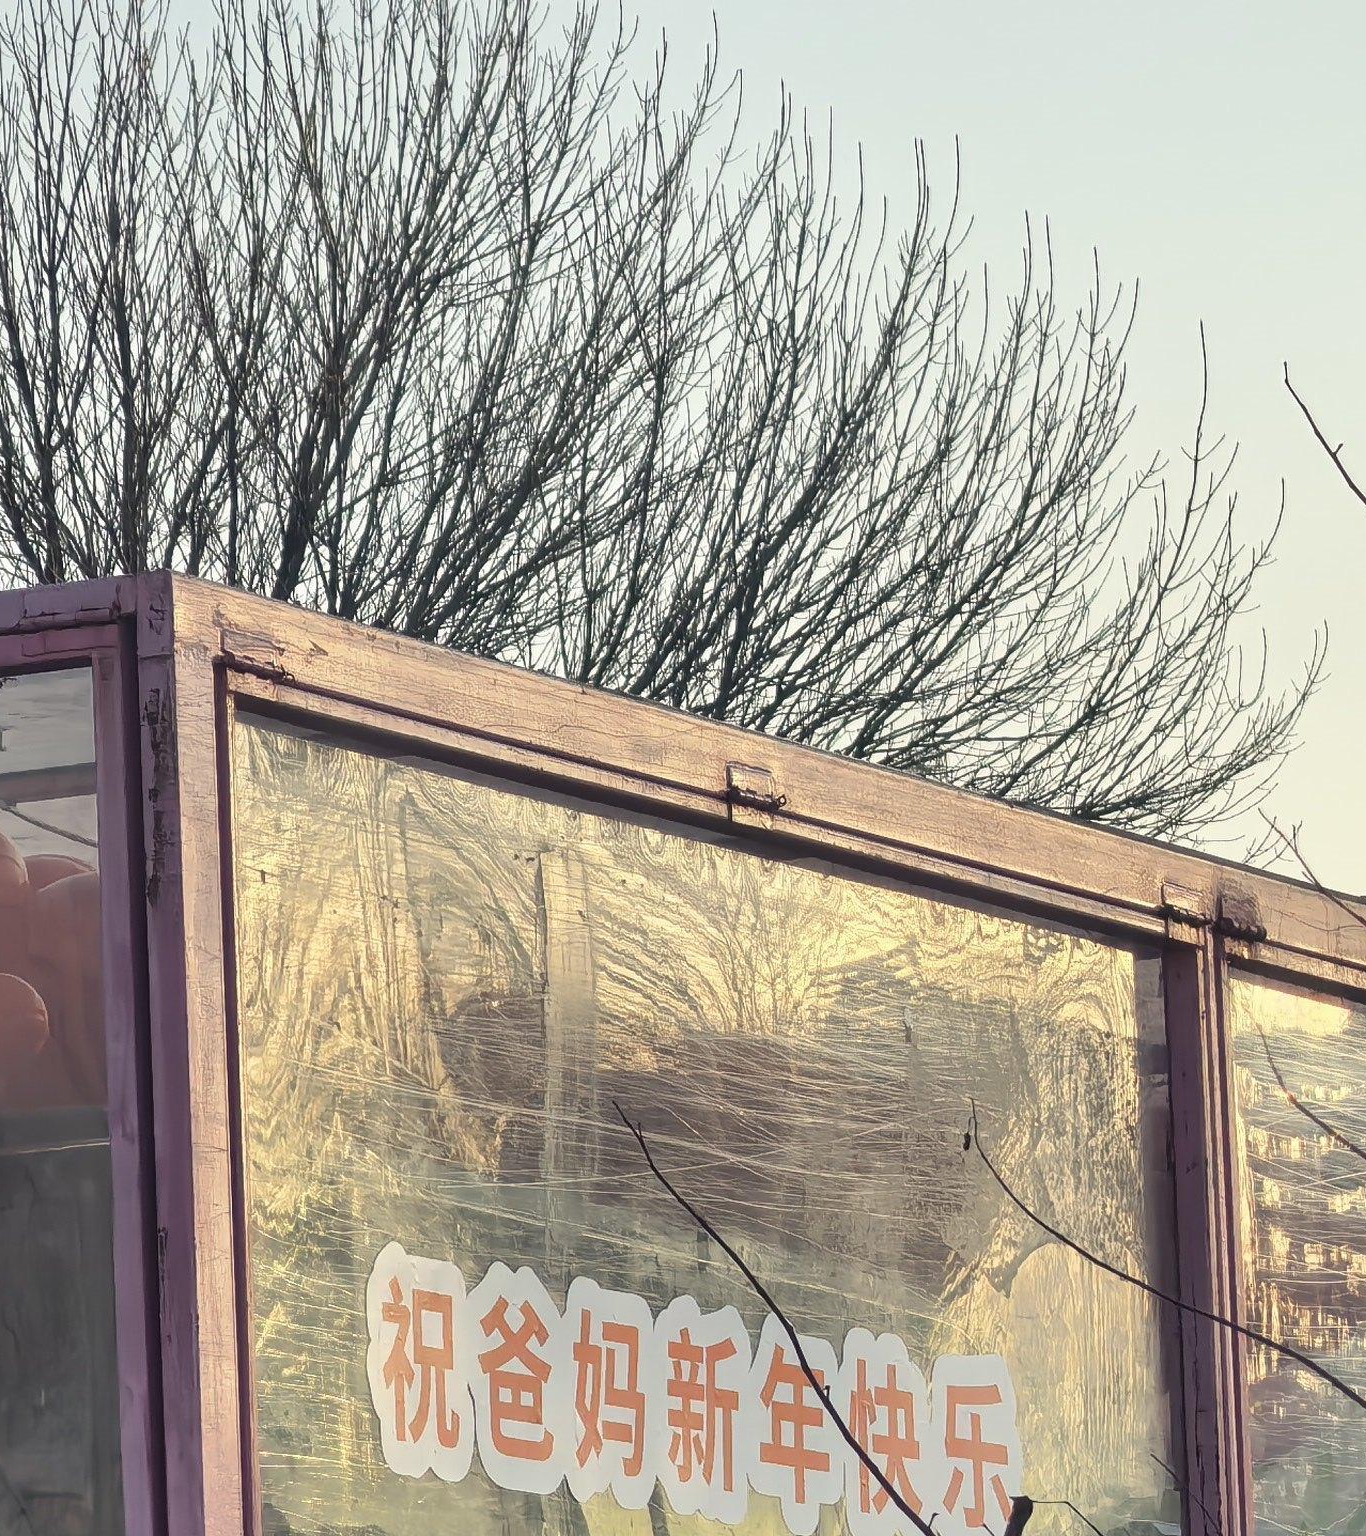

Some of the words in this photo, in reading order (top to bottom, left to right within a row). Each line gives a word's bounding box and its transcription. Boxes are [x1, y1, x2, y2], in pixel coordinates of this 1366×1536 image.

[380, 1274, 1013, 1530] 祝爸妈新年快乐
